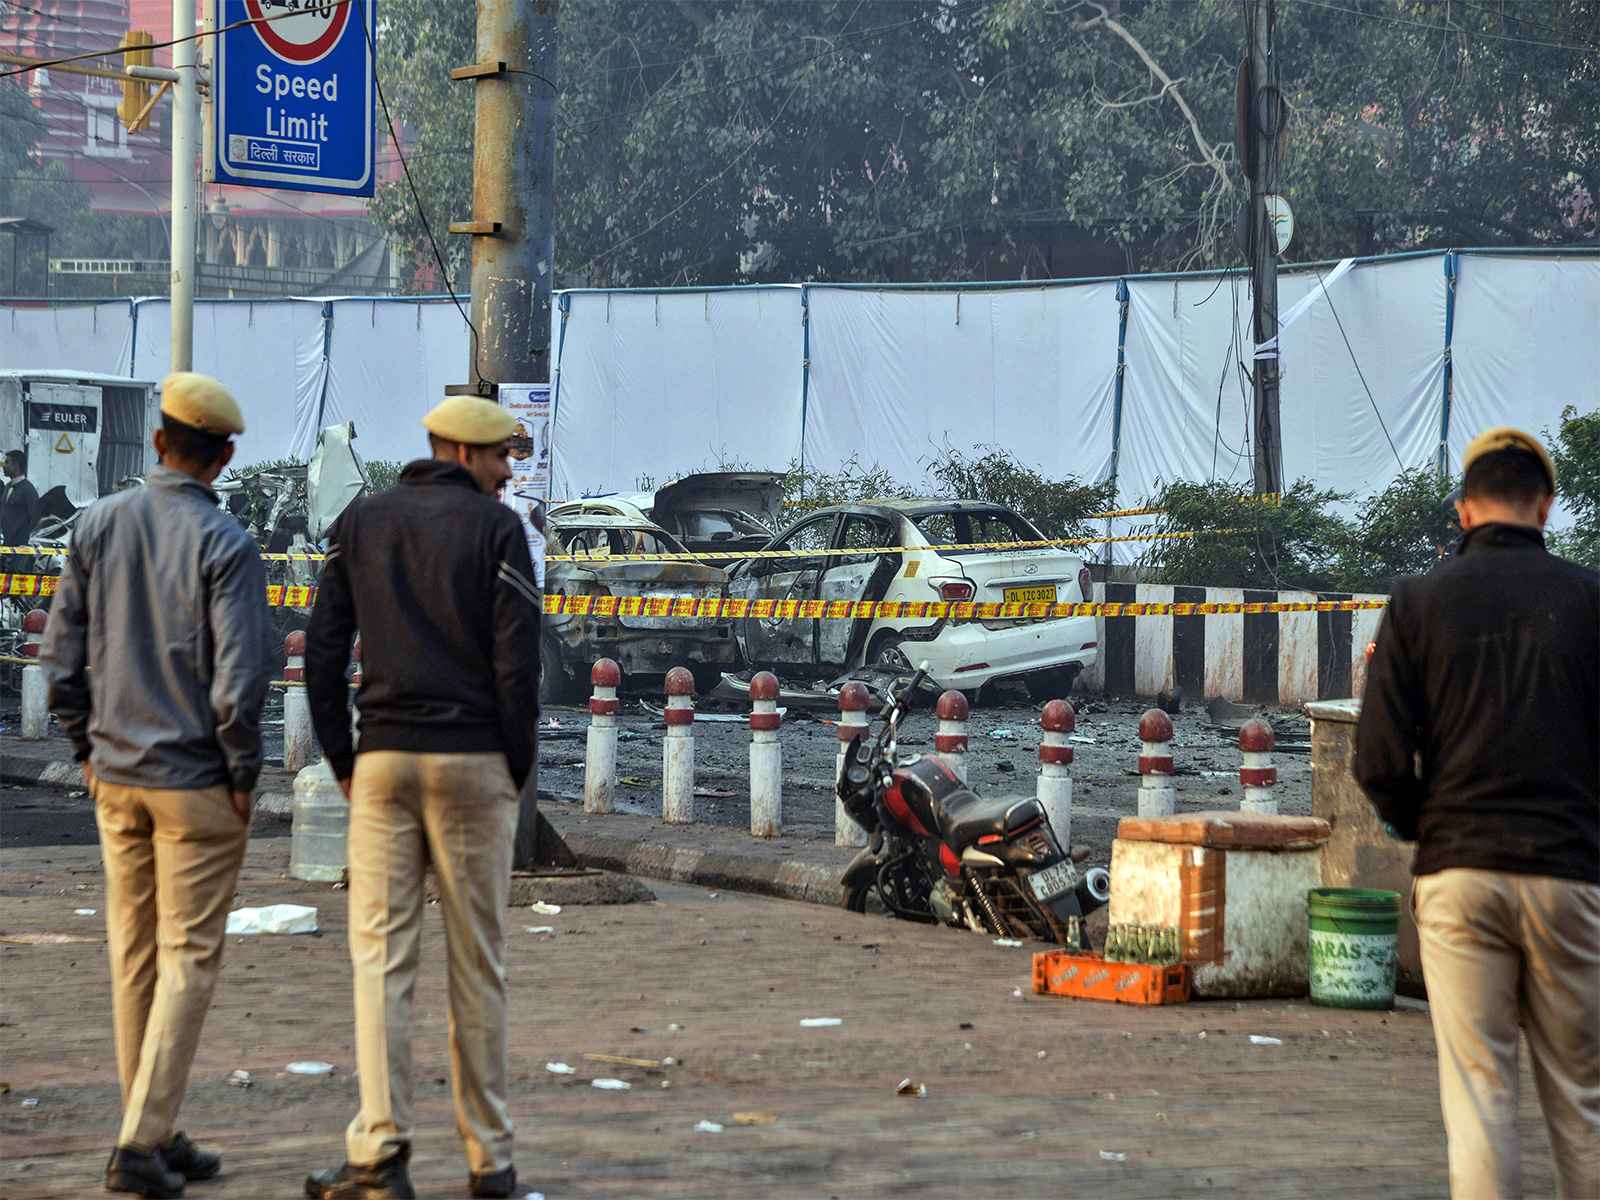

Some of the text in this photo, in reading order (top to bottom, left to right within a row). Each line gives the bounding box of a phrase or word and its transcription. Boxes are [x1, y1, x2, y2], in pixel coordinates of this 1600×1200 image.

[255, 63, 337, 101] Speed
[266, 107, 328, 141] Limit
[250, 142, 316, 165] दिल्ली सरकार
[54, 412, 88, 424] EULER
[1010, 591, 1020, 602] DL
